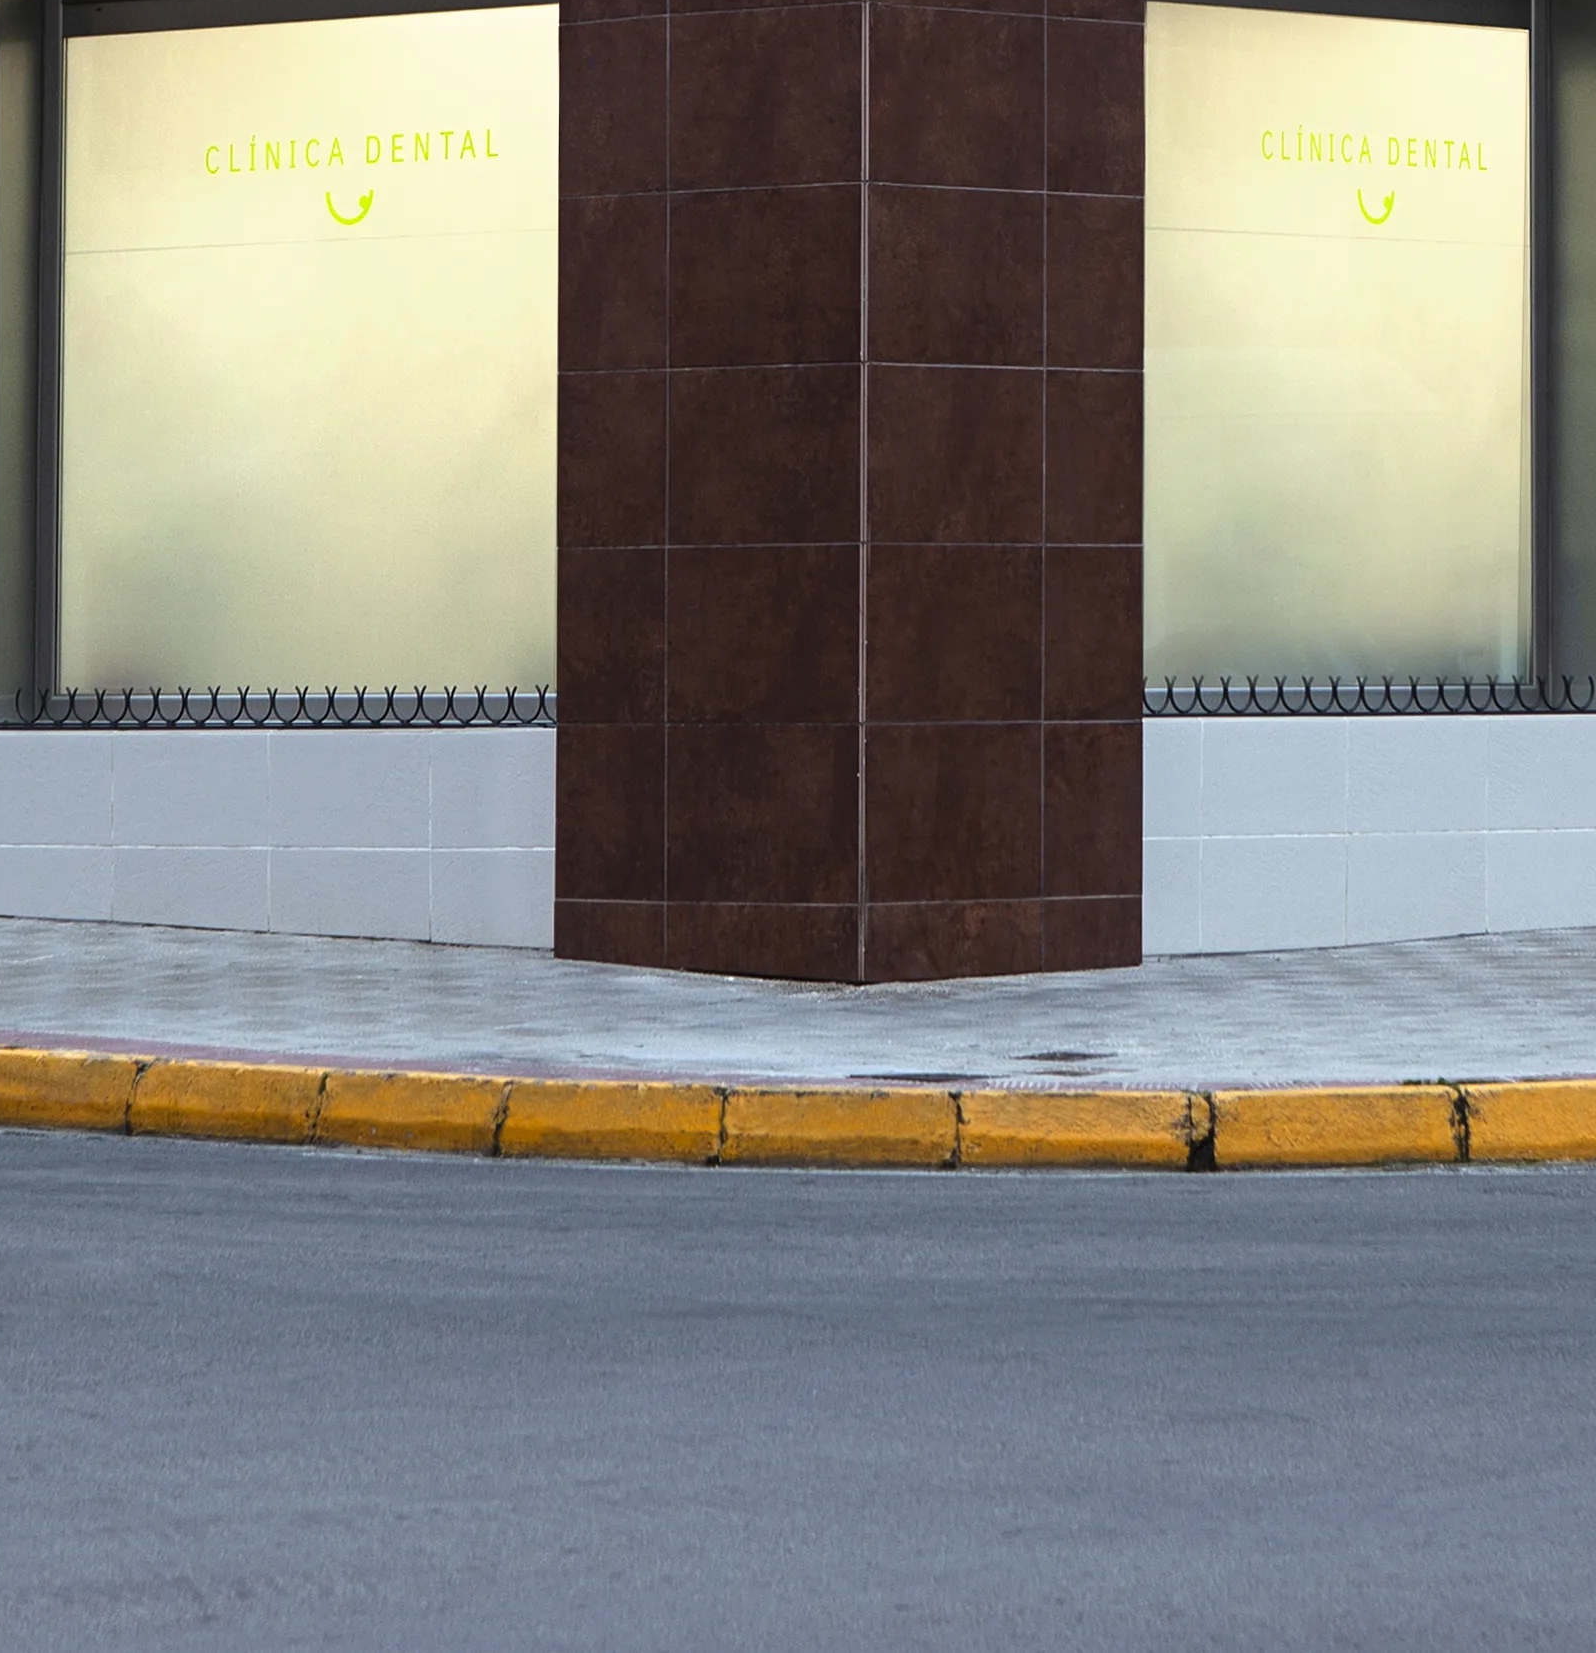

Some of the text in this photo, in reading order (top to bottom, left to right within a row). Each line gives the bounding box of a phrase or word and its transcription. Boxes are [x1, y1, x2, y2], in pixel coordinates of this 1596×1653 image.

[204, 128, 499, 176] CLÍNICA DENTAL
[1260, 124, 1488, 173] CLÍNICA DENTAL
